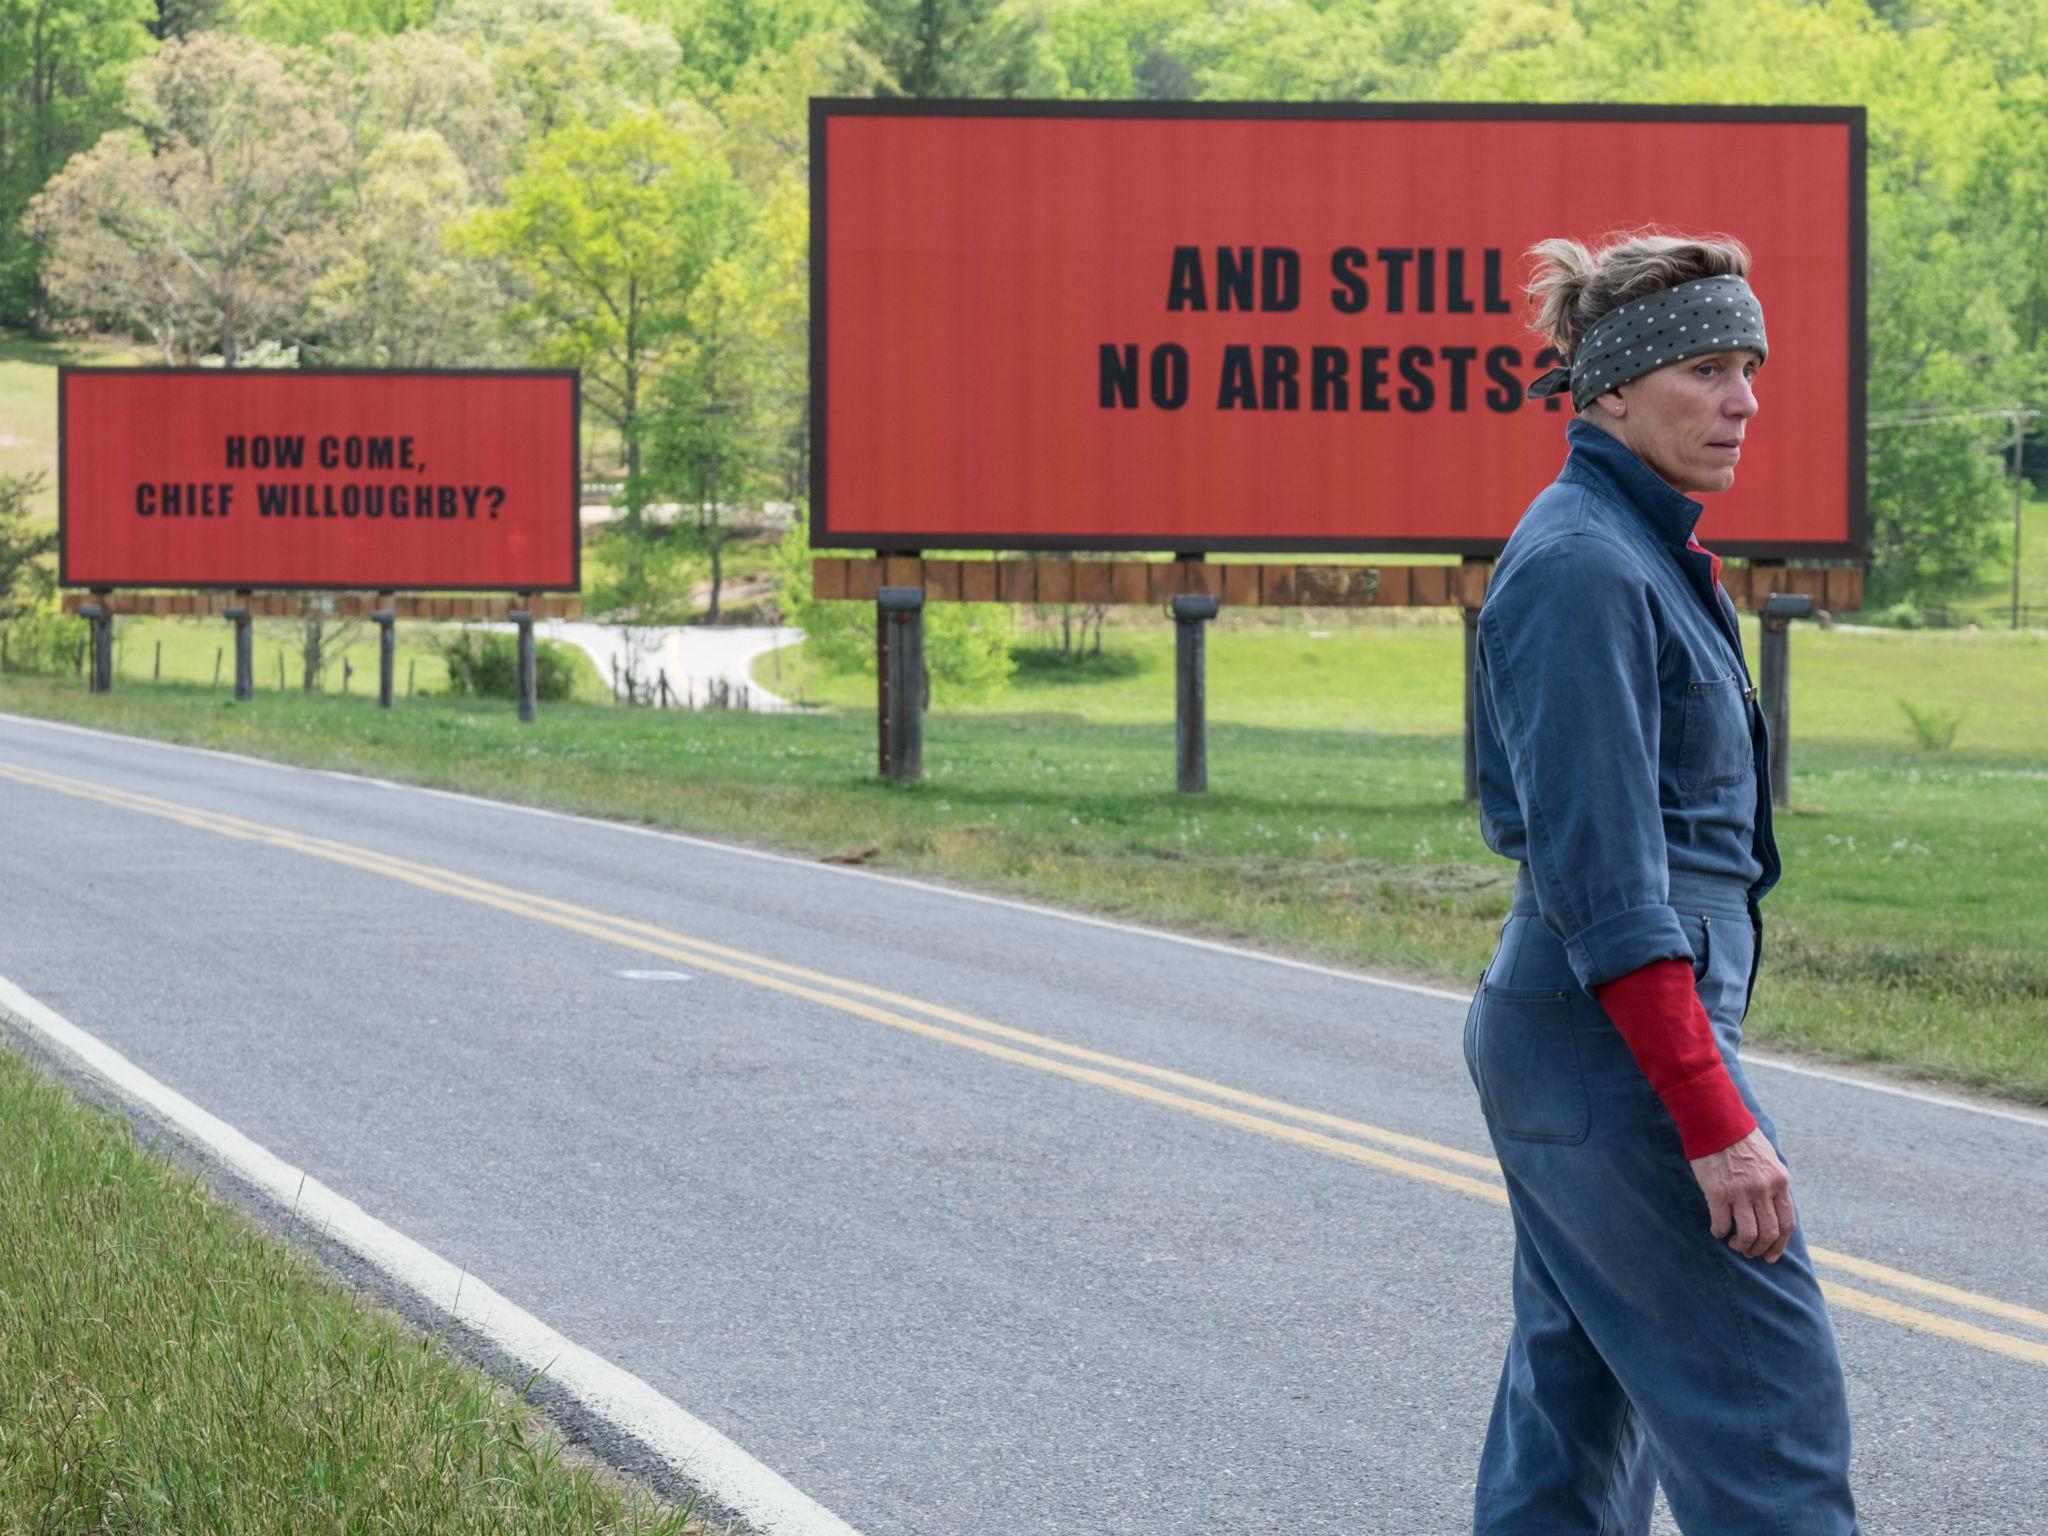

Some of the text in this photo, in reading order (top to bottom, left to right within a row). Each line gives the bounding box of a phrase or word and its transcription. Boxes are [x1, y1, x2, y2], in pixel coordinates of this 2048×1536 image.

[1166, 245, 1511, 315] AND STILL
[1099, 342, 1189, 411] NO
[225, 435, 427, 474] HOW COME,
[135, 482, 506, 520] CHIEF WILLOUGHBY?
